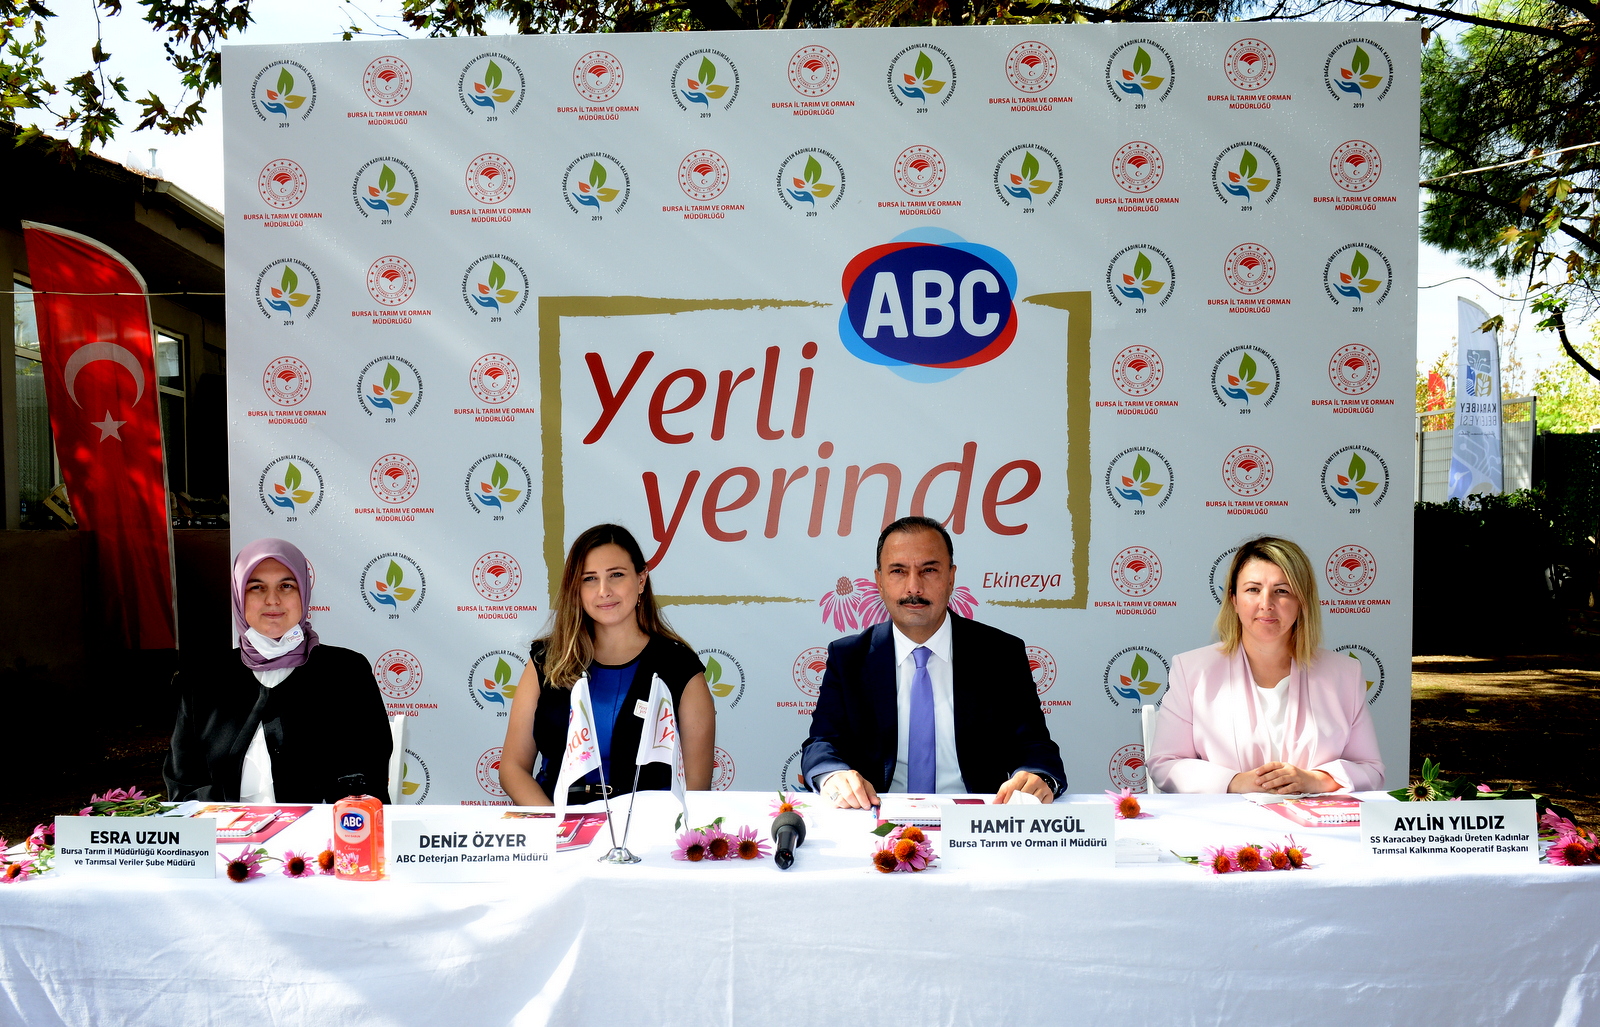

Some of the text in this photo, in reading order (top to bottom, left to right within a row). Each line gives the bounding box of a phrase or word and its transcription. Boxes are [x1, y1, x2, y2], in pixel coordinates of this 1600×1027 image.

[368, 118, 408, 126] MÜDÜRLÜĞÜ
[264, 220, 304, 228] MÜDÜRLÜĞÜ
[862, 269, 1001, 339] ABC
[582, 341, 819, 445] Yerli
[642, 441, 1042, 571] yerinde
[982, 571, 1062, 592] Ekinezya
[343, 816, 363, 827] ABC
[971, 816, 1085, 833] HAMİT AYGÜL
[1394, 814, 1505, 831] AYLİN YILDIZ
[90, 830, 180, 845] ESRA UZUN
[419, 831, 526, 848] DENİZ ÖZYER
[949, 839, 977, 848] Bursa
[980, 839, 1008, 848] Tarım
[1010, 840, 1022, 848] ve
[1024, 838, 1058, 848] Orman
[1069, 838, 1107, 847] Müdürü
[1383, 835, 1426, 844] Karacabey
[1429, 834, 1462, 843] Dağkadı
[1465, 833, 1493, 842] Üreten
[1495, 833, 1529, 841] Kadınlar
[61, 847, 82, 855] Bursa
[114, 848, 155, 857] Müdürlüğü
[156, 848, 209, 857] Koordinasyon
[1372, 845, 1528, 855] Tarımsal Kalkınma Kooperatif Başkanı
[85, 858, 117, 866] Tarımsal
[118, 858, 144, 866] Veriler
[145, 858, 165, 867] Şube
[396, 853, 548, 864] ABC Deterjan Pazarlama Müdürü
